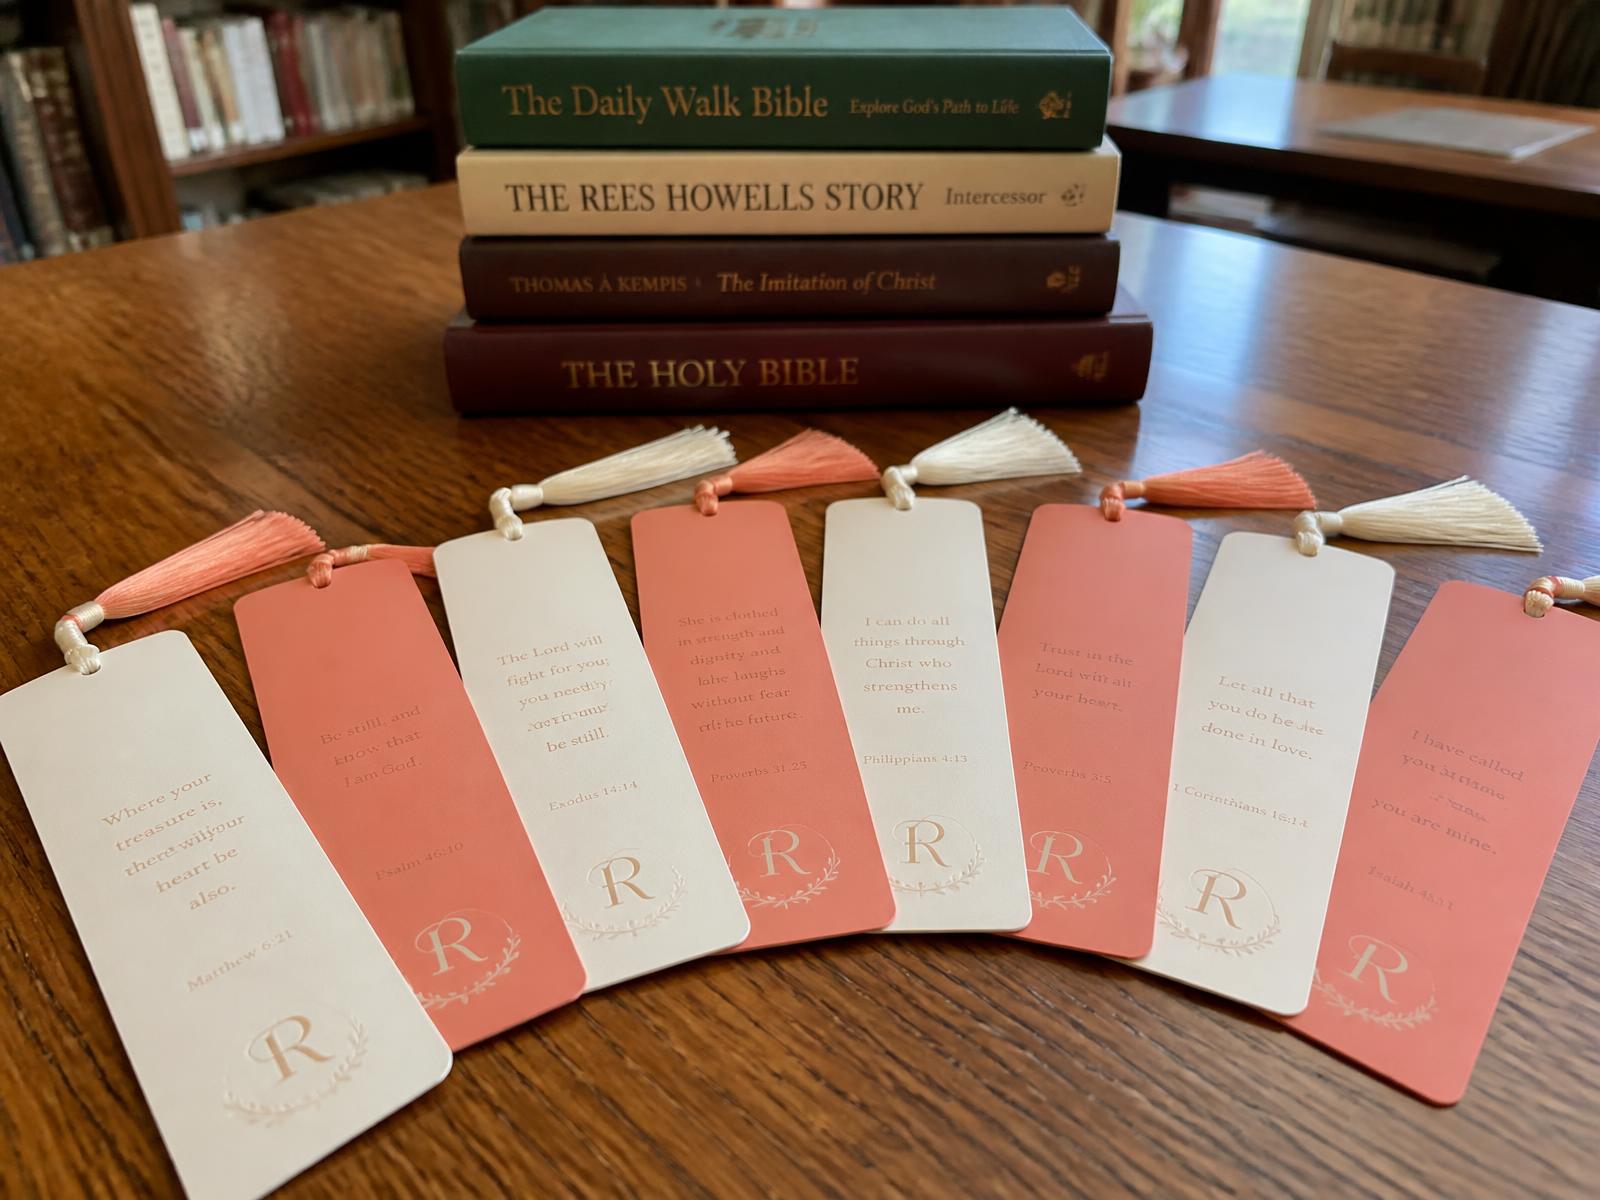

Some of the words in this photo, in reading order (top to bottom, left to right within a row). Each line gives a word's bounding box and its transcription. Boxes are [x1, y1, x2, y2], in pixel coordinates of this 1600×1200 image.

[502, 84, 562, 116] The
[570, 84, 653, 125] Daily
[660, 84, 742, 118] Walk
[752, 85, 829, 118] Bible
[850, 100, 899, 119] Explore
[902, 100, 940, 115] God's
[942, 100, 972, 115] Path
[976, 102, 989, 114] to
[991, 99, 1020, 115] Life
[504, 184, 571, 213] THE
[579, 184, 656, 213] REES
[666, 183, 815, 213] HOWELLS
[825, 183, 924, 212] STORY
[944, 187, 1047, 205] Intercessor
[509, 276, 594, 293] THOMAS
[618, 276, 688, 292] KEMPIS
[717, 272, 754, 292] The
[760, 273, 850, 292] Imitation
[852, 272, 876, 295] of
[877, 272, 938, 291] Christ
[561, 361, 638, 389] THE
[648, 360, 747, 389] HOLY
[759, 358, 859, 387] BIBLE
[677, 617, 705, 628] She
[710, 614, 721, 623] is
[725, 607, 779, 622] clothed
[865, 617, 871, 627] I
[876, 618, 902, 627] can
[907, 616, 927, 627] do
[931, 616, 951, 627] all
[677, 637, 692, 647] in
[695, 629, 755, 645] strength
[758, 626, 785, 637] and
[853, 636, 900, 649] things
[904, 636, 966, 649] through
[497, 651, 529, 666] The
[532, 642, 570, 657] Lord
[574, 635, 603, 648] will
[689, 651, 746, 667] dignity
[750, 645, 782, 657] and
[1039, 641, 1081, 658] Trust
[1107, 653, 1135, 666] the
[865, 658, 913, 669] Christ
[919, 658, 952, 668] who
[1034, 662, 1074, 678] Lord
[506, 671, 544, 687] fight
[550, 664, 575, 676] for
[863, 680, 959, 694] strengthens
[519, 693, 549, 712] you
[690, 693, 754, 710] without
[759, 688, 791, 701] fear
[1031, 687, 1074, 702] your
[1217, 675, 1248, 692] Let
[1251, 685, 1274, 698] all
[1278, 691, 1317, 709] that
[391, 706, 422, 723] and
[896, 704, 925, 714] me.
[1207, 700, 1241, 714] you
[1244, 707, 1268, 721] do
[1271, 713, 1294, 727] be
[386, 730, 422, 749] that
[546, 742, 568, 752] be
[1200, 722, 1245, 741] done
[1247, 733, 1267, 747] in
[1271, 739, 1313, 760] love.
[1423, 733, 1466, 757] have
[863, 753, 938, 766] Philippians
[1022, 761, 1087, 780] Proverbs
[1401, 753, 1437, 773] you
[353, 772, 379, 785] am
[101, 793, 166, 827] Where
[169, 773, 213, 801] your
[549, 793, 600, 812] Exodus
[1184, 785, 1267, 816] Corinthians
[114, 807, 197, 852] treasure
[1370, 798, 1407, 817] you
[1410, 814, 1441, 831] are
[1445, 827, 1497, 855] mine.
[747, 829, 811, 878] R
[892, 819, 952, 868] R
[124, 846, 178, 877] there
[1027, 830, 1084, 885] R
[155, 860, 212, 894] heart
[213, 847, 239, 865] be
[189, 883, 237, 911] also.
[1185, 868, 1247, 930] R
[415, 916, 489, 977] R
[186, 948, 258, 993] Matthew
[1337, 934, 1409, 1005] R
[248, 1014, 336, 1085] R
